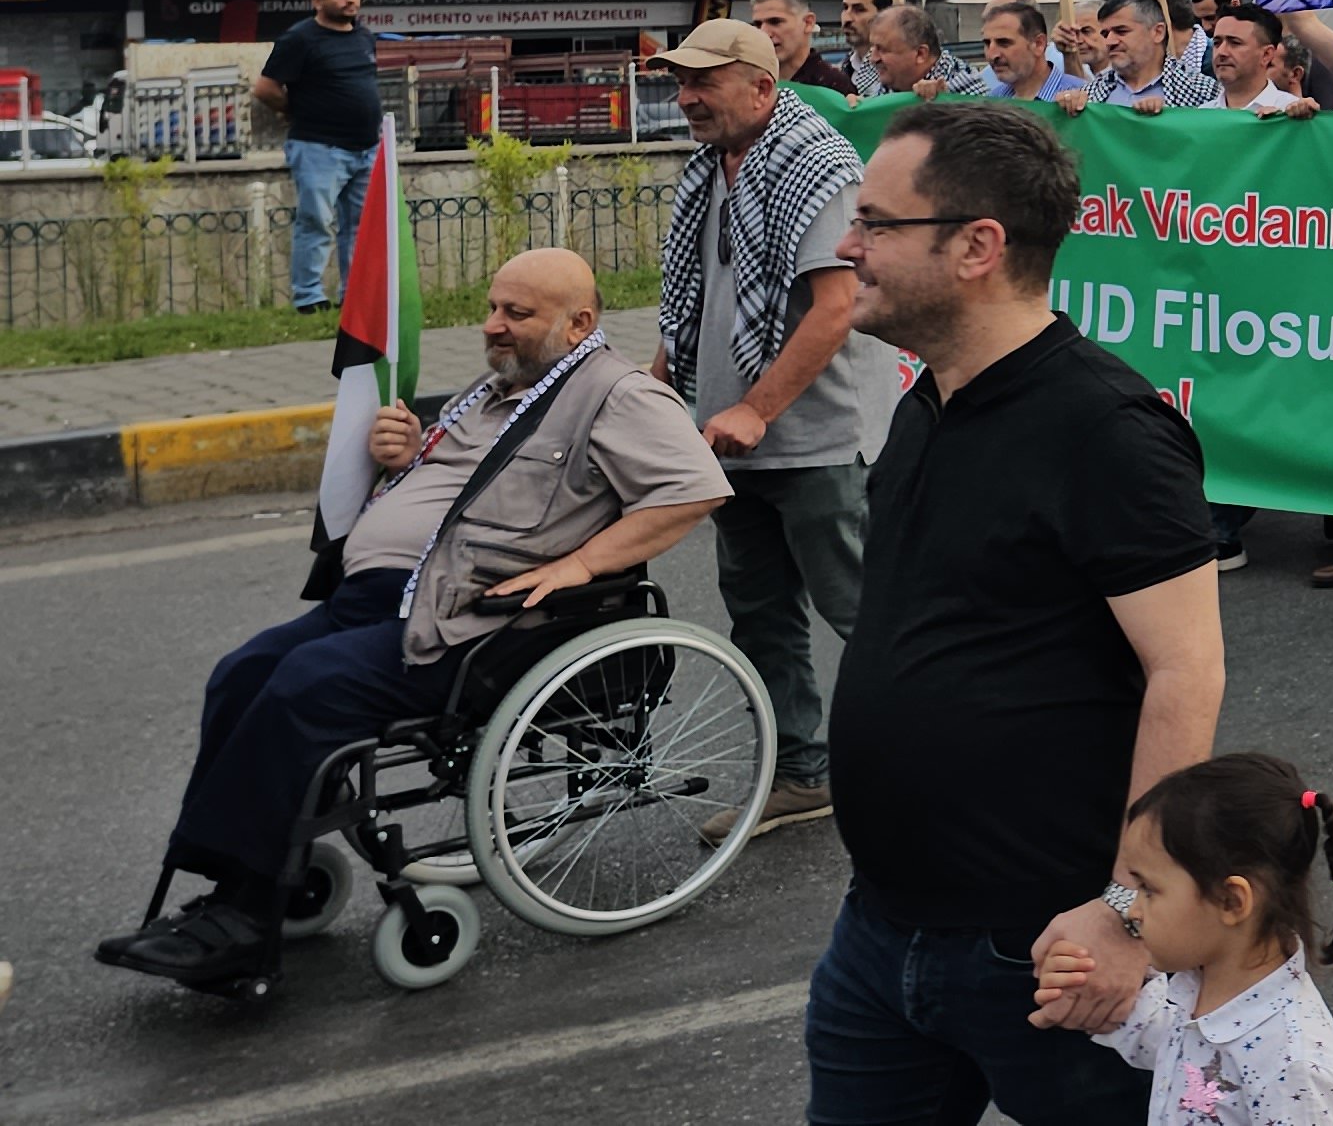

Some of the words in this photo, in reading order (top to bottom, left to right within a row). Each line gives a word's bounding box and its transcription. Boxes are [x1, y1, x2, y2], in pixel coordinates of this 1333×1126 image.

[359, 13, 394, 26] EMİR
[407, 10, 472, 26] ÇİMENTO
[477, 13, 493, 24] ve
[553, 7, 648, 23] MALZEMELERİ
